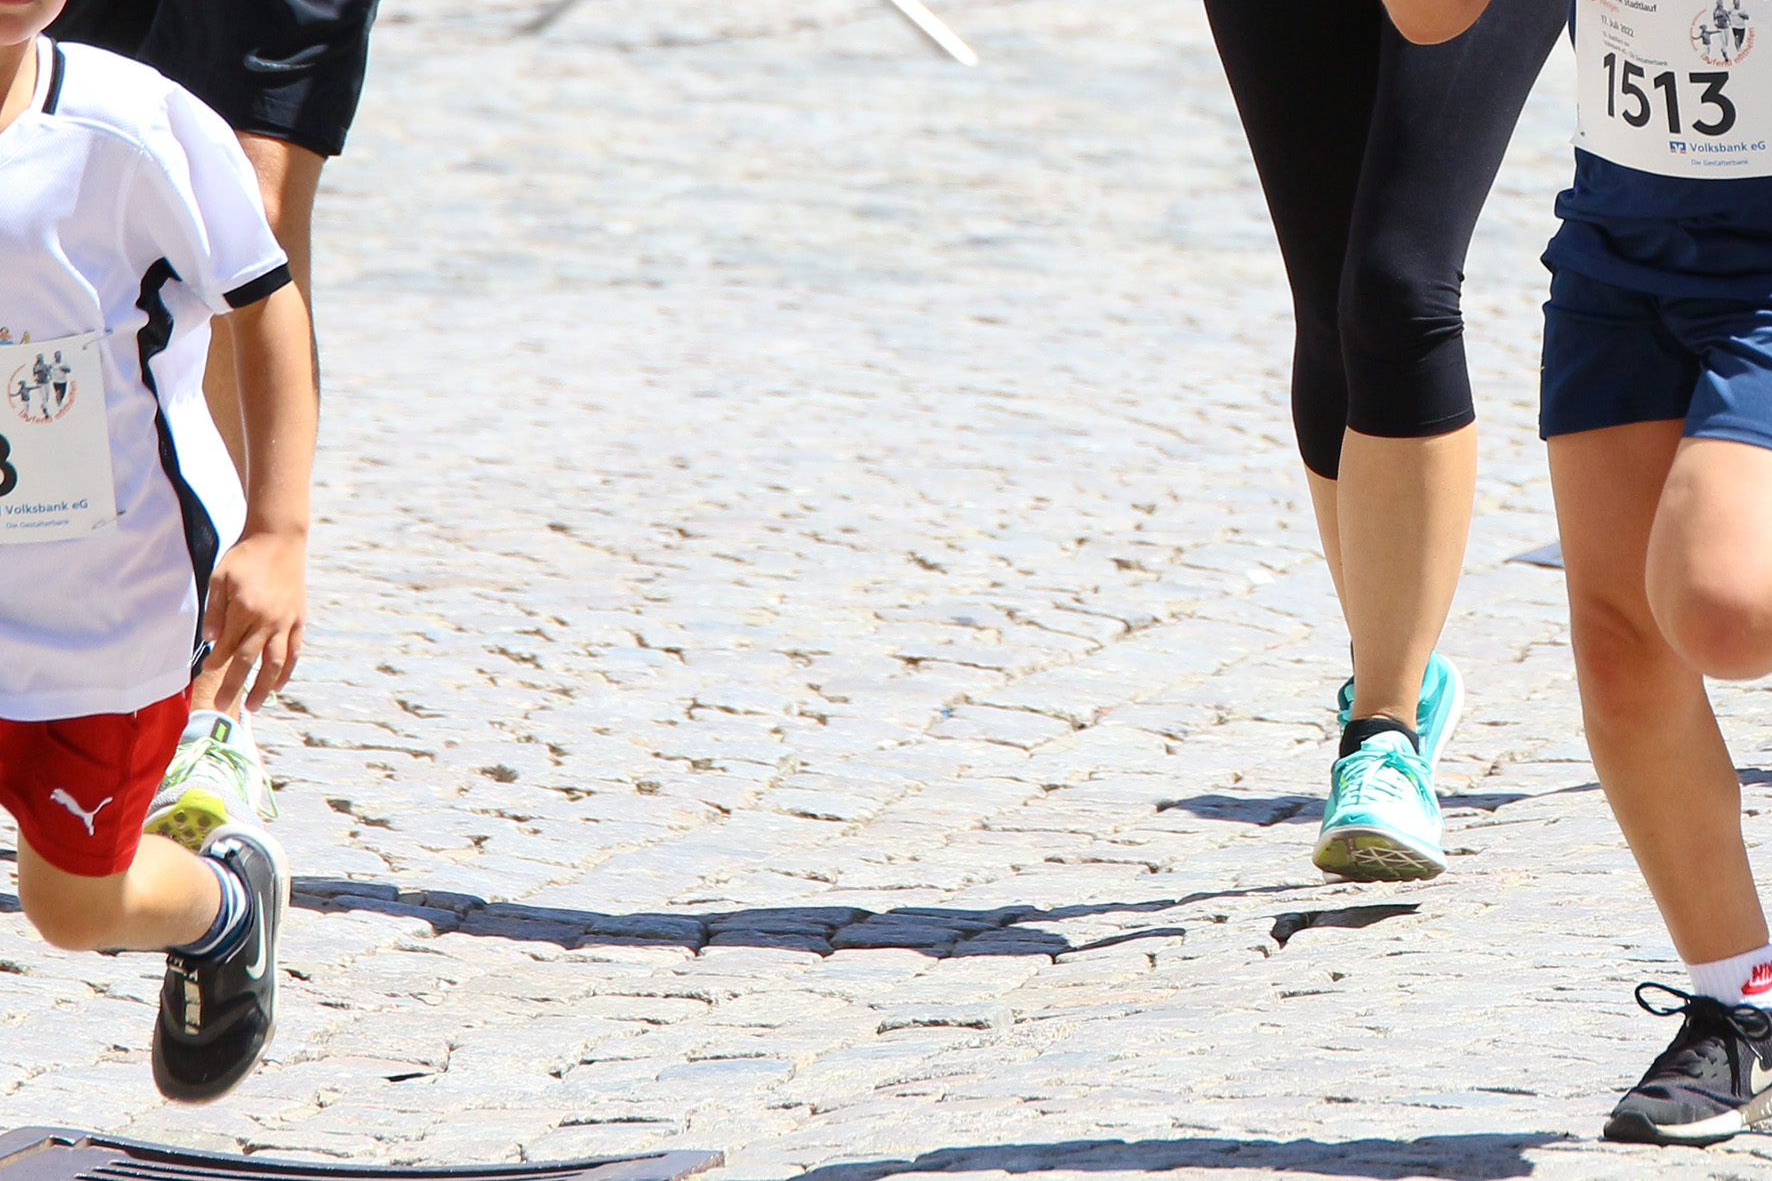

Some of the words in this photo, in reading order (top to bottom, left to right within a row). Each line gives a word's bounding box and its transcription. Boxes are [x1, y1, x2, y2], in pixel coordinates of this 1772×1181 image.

[1603, 51, 1736, 136] 1513
[1690, 142, 1748, 153] Volksbank
[1751, 141, 1766, 151] eG
[5, 501, 69, 515] Volksbank
[72, 499, 88, 510] eG
